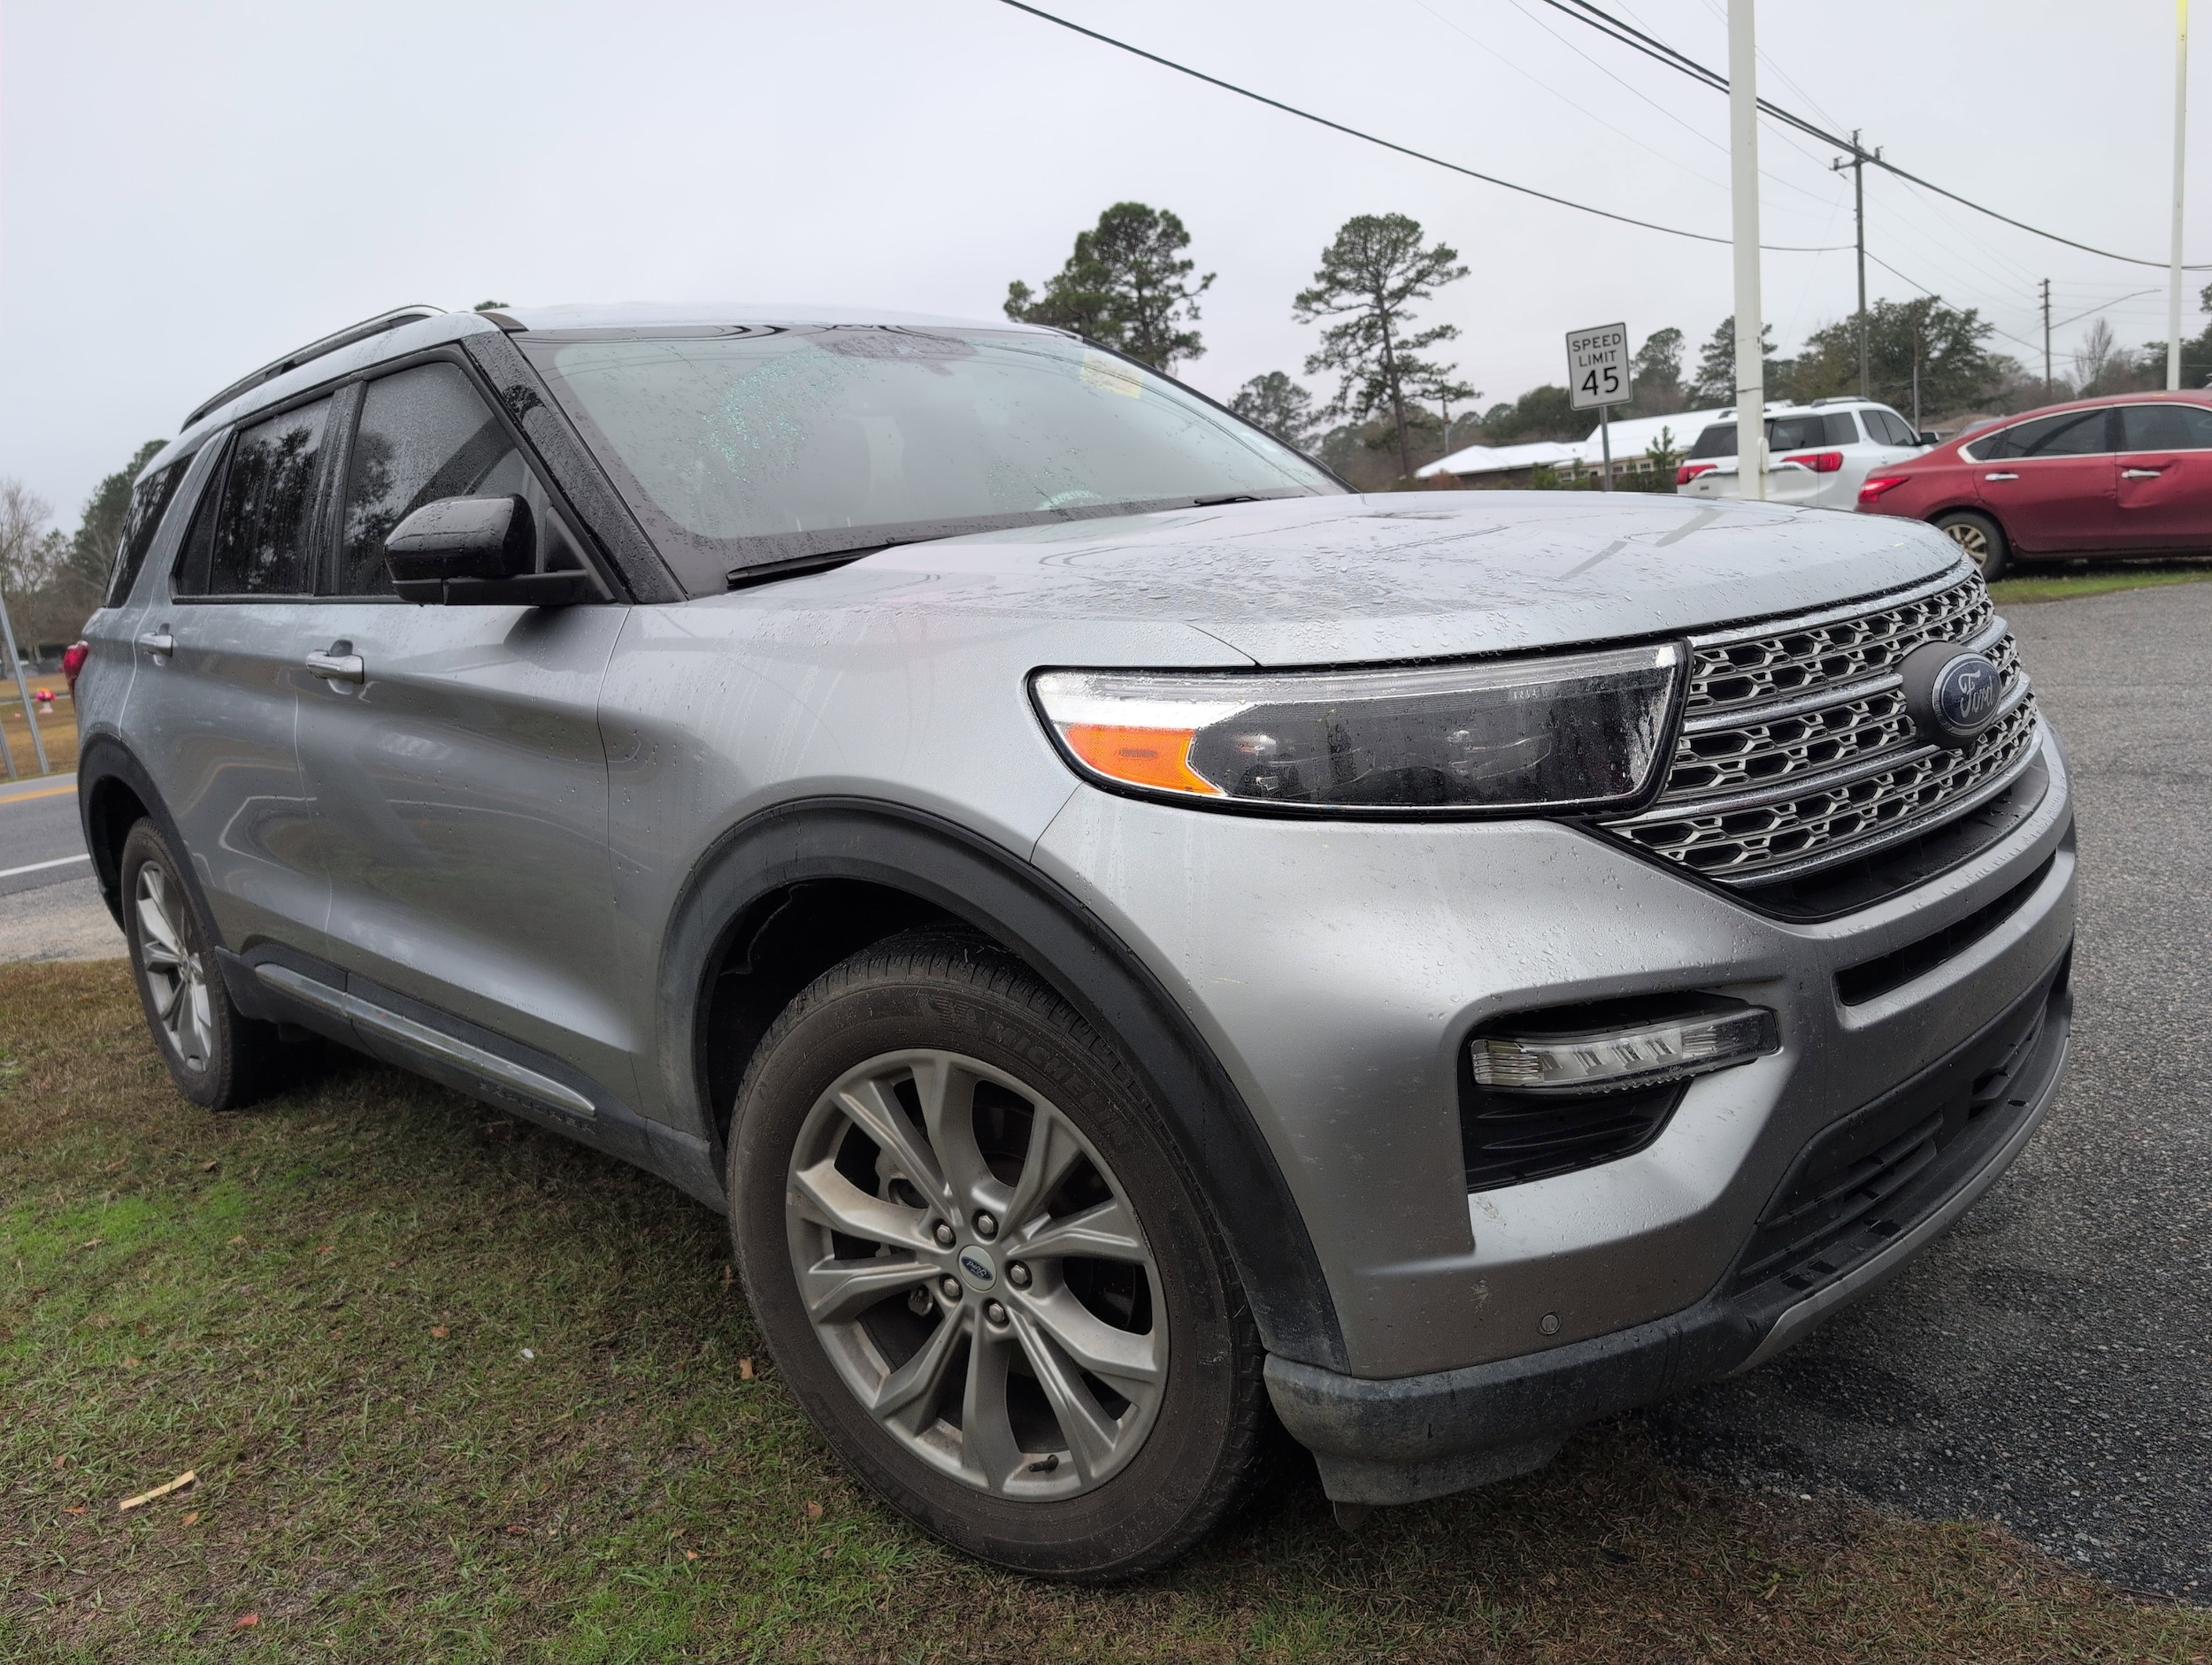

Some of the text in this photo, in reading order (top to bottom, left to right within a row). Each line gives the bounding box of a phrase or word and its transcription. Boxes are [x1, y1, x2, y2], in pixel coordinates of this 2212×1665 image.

[1571, 333, 1622, 352] SPEED
[1578, 349, 1617, 367] LIMIT
[1581, 366, 1619, 395] 45
[1958, 670, 1993, 718] Ford
[985, 1020, 1133, 1148] MICHELIN
[965, 1260, 988, 1278] Ford
